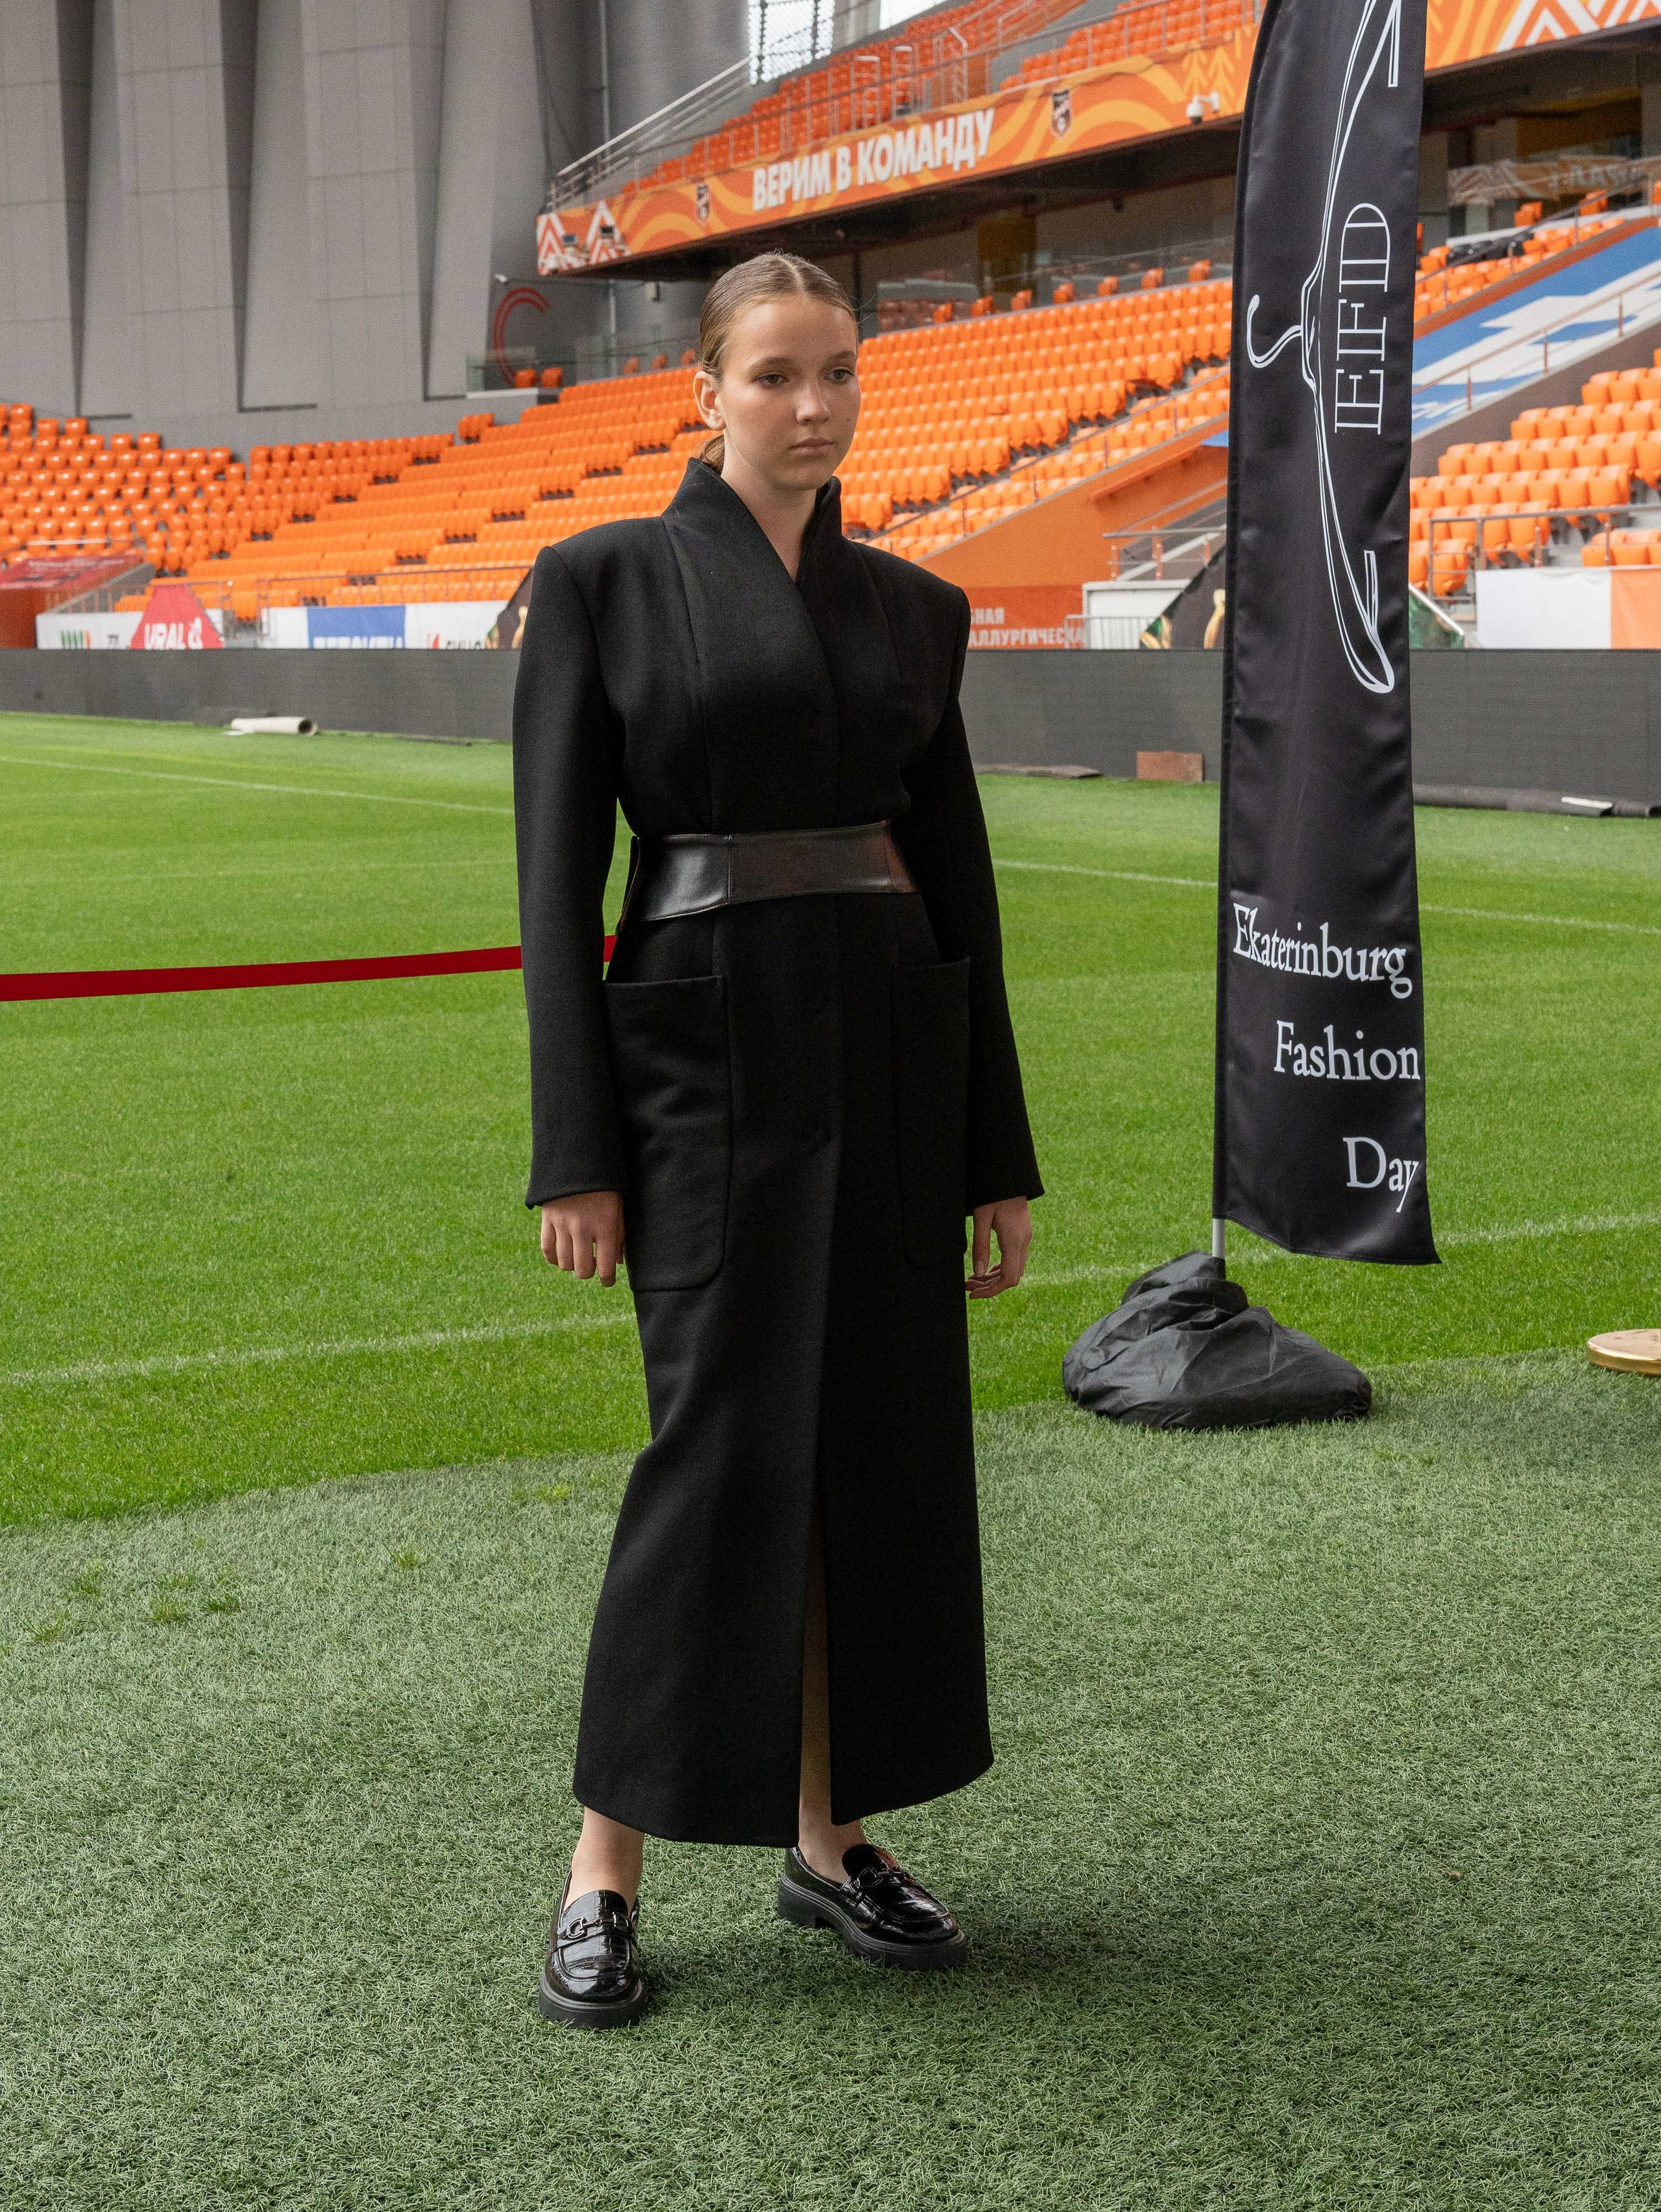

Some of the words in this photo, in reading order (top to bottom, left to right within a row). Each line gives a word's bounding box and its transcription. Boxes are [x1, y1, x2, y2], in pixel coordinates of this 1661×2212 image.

[753, 150, 831, 211] ВЕРИМ
[836, 147, 852, 191] В
[857, 107, 995, 186] КОМАНДУ
[1335, 203, 1390, 435] EFD
[971, 607, 1005, 625] НАЯ
[1233, 902, 1412, 999] Ekaterinburg
[1274, 1020, 1421, 1080] Fashion
[1342, 1136, 1419, 1213] Day
